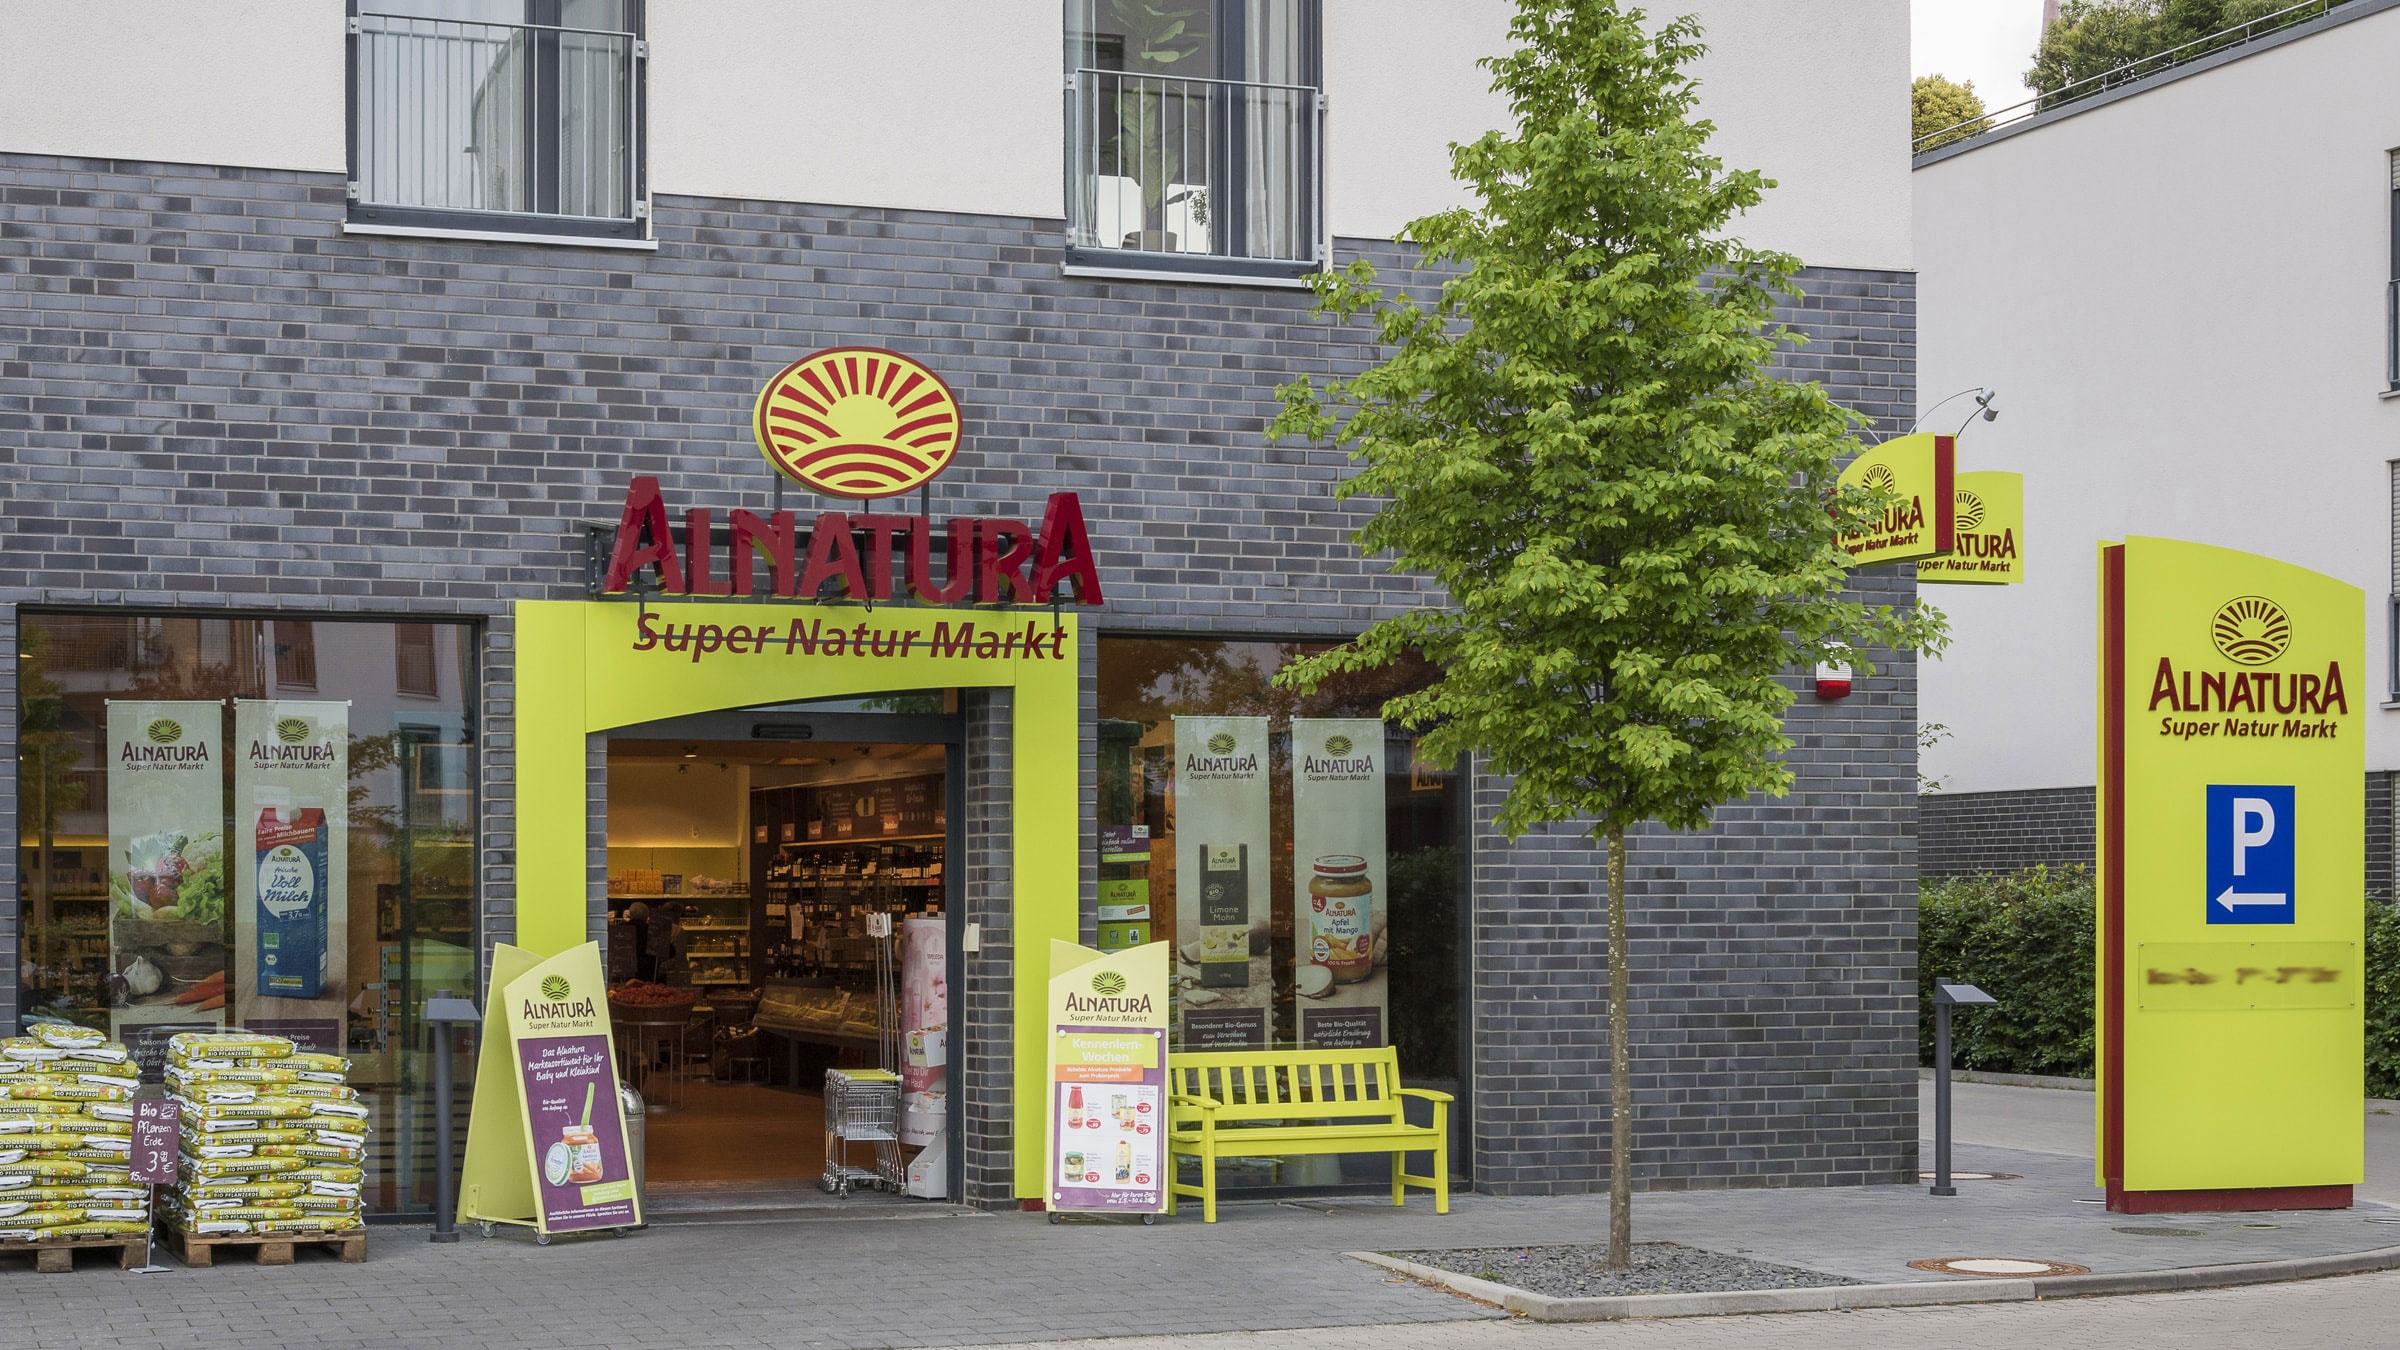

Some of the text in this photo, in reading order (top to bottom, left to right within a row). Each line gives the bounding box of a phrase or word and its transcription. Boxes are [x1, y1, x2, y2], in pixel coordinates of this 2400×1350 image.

[602, 476, 1104, 606] ALNATURA
[1865, 538, 1889, 551] Natur
[1889, 532, 1919, 547] Markt
[1956, 528, 2017, 559] ATURA
[1916, 559, 2010, 572] uper Natur Markt
[632, 612, 1067, 663] Super Natur Markt
[2148, 657, 2348, 715] ALNATURA
[2160, 717, 2337, 741] Super Natur Markt
[121, 741, 208, 762] ALNATURA
[250, 740, 335, 761] ALNATURA
[126, 763, 150, 771] Super
[254, 762, 278, 770] Super
[1186, 754, 1258, 772] ALNATURA
[1304, 755, 1374, 773] ALNATURA
[1190, 773, 1210, 781] Super
[1308, 774, 1328, 782] Super
[277, 828, 314, 838] Milchbauern
[2232, 797, 2275, 876] P
[271, 874, 301, 888] Voll
[264, 889, 309, 901] Milch
[1326, 908, 1356, 917] ALNATURA
[1336, 927, 1358, 935] Mango
[524, 997, 595, 1019] ALNATURA
[1065, 992, 1152, 1013] ALNATURA
[1070, 1014, 1094, 1022] Super
[1096, 1014, 1120, 1022] Natur
[529, 1022, 549, 1030] Super
[1072, 1039, 1143, 1049] Kennenlern-
[543, 1045, 585, 1057] Das Alnatura
[1082, 1051, 1129, 1062] Wochen
[583, 1055, 592, 1065] für
[594, 1052, 604, 1062] Ihr
[536, 1064, 600, 1084] Baby und Kleinkind
[140, 1103, 157, 1117] Bio
[137, 1121, 171, 1134] Pflanzen
[144, 1136, 164, 1146] Erde
[147, 1151, 158, 1172] 3
